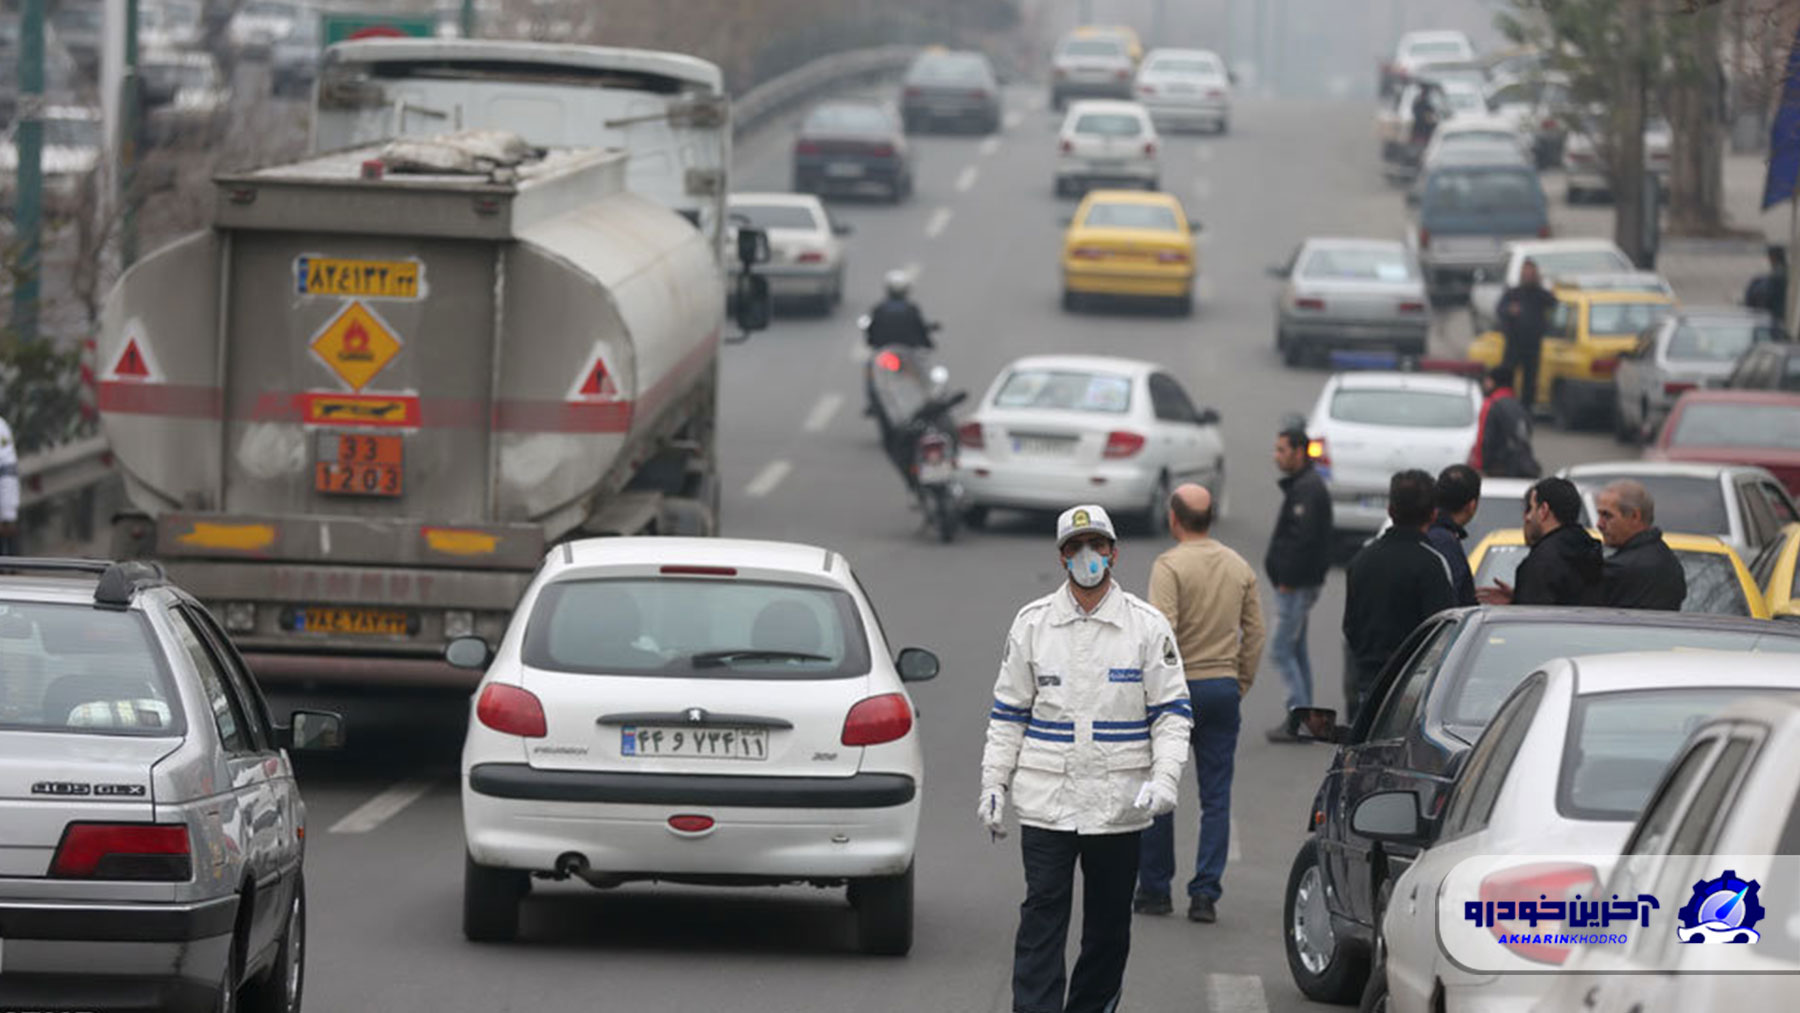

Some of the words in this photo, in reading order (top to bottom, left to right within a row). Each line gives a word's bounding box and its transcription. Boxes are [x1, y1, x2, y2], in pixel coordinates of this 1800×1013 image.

[343, 436, 378, 461] 33
[322, 465, 398, 491] 1203
[32, 783, 90, 795] 405
[94, 785, 146, 796] GLX
